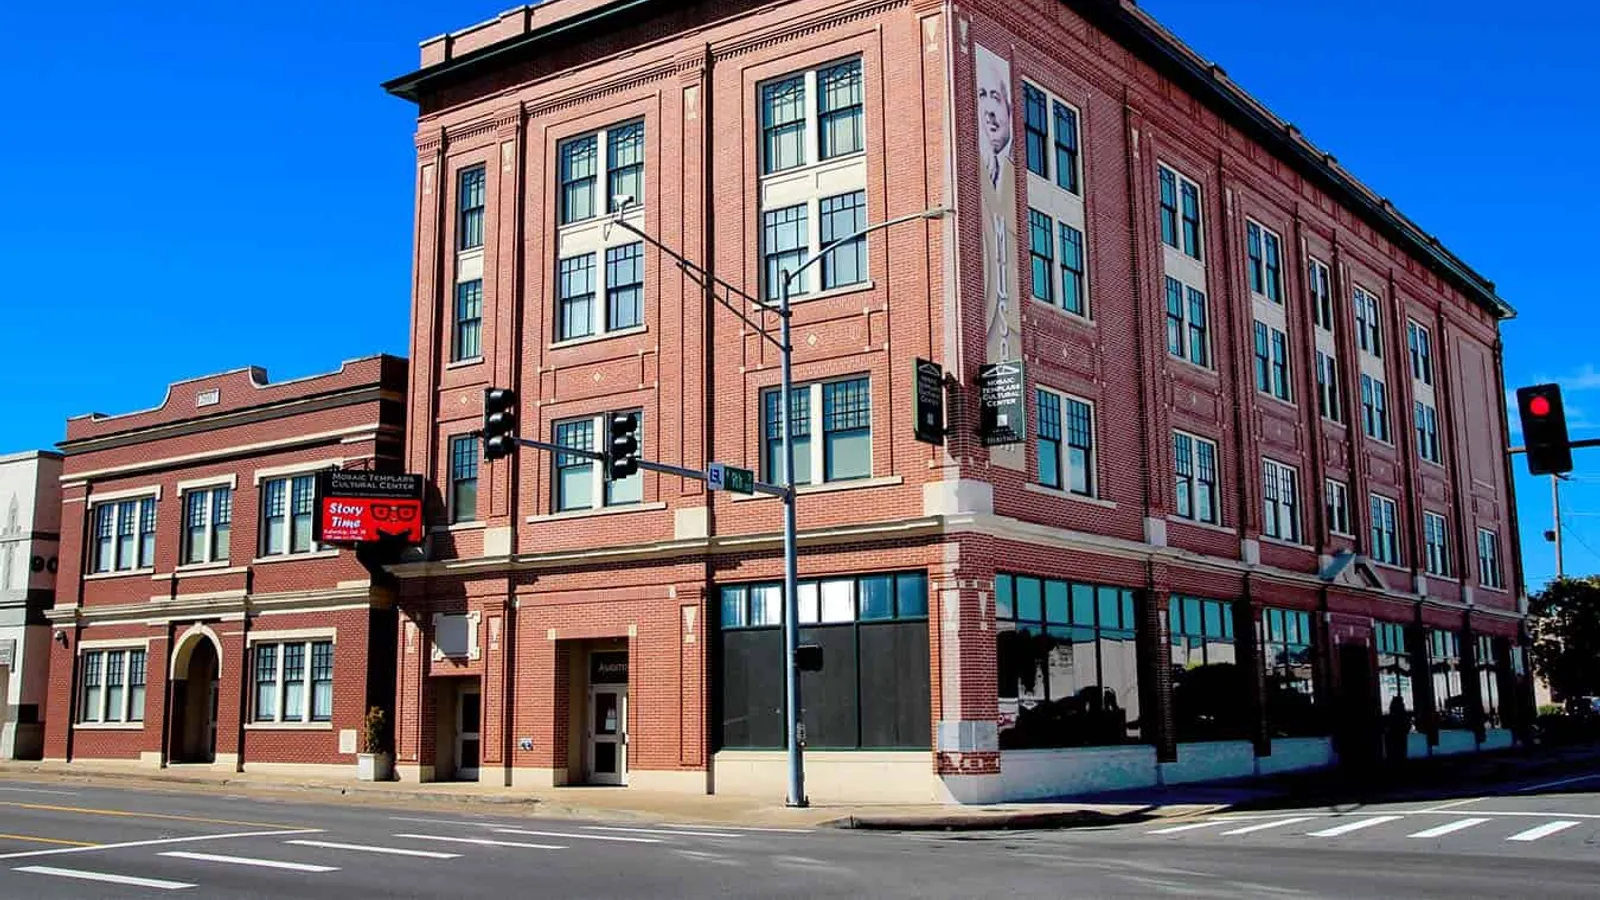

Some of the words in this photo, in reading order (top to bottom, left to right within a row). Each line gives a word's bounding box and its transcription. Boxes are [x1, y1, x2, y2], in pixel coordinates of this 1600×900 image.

[986, 398, 1016, 407] CENTER
[331, 473, 367, 481] MOSAIC
[369, 474, 415, 482] TEMPLARS
[331, 480, 378, 489] CULTURAL
[379, 481, 415, 489] CENTER
[329, 502, 363, 516] Story
[331, 516, 361, 528] Time
